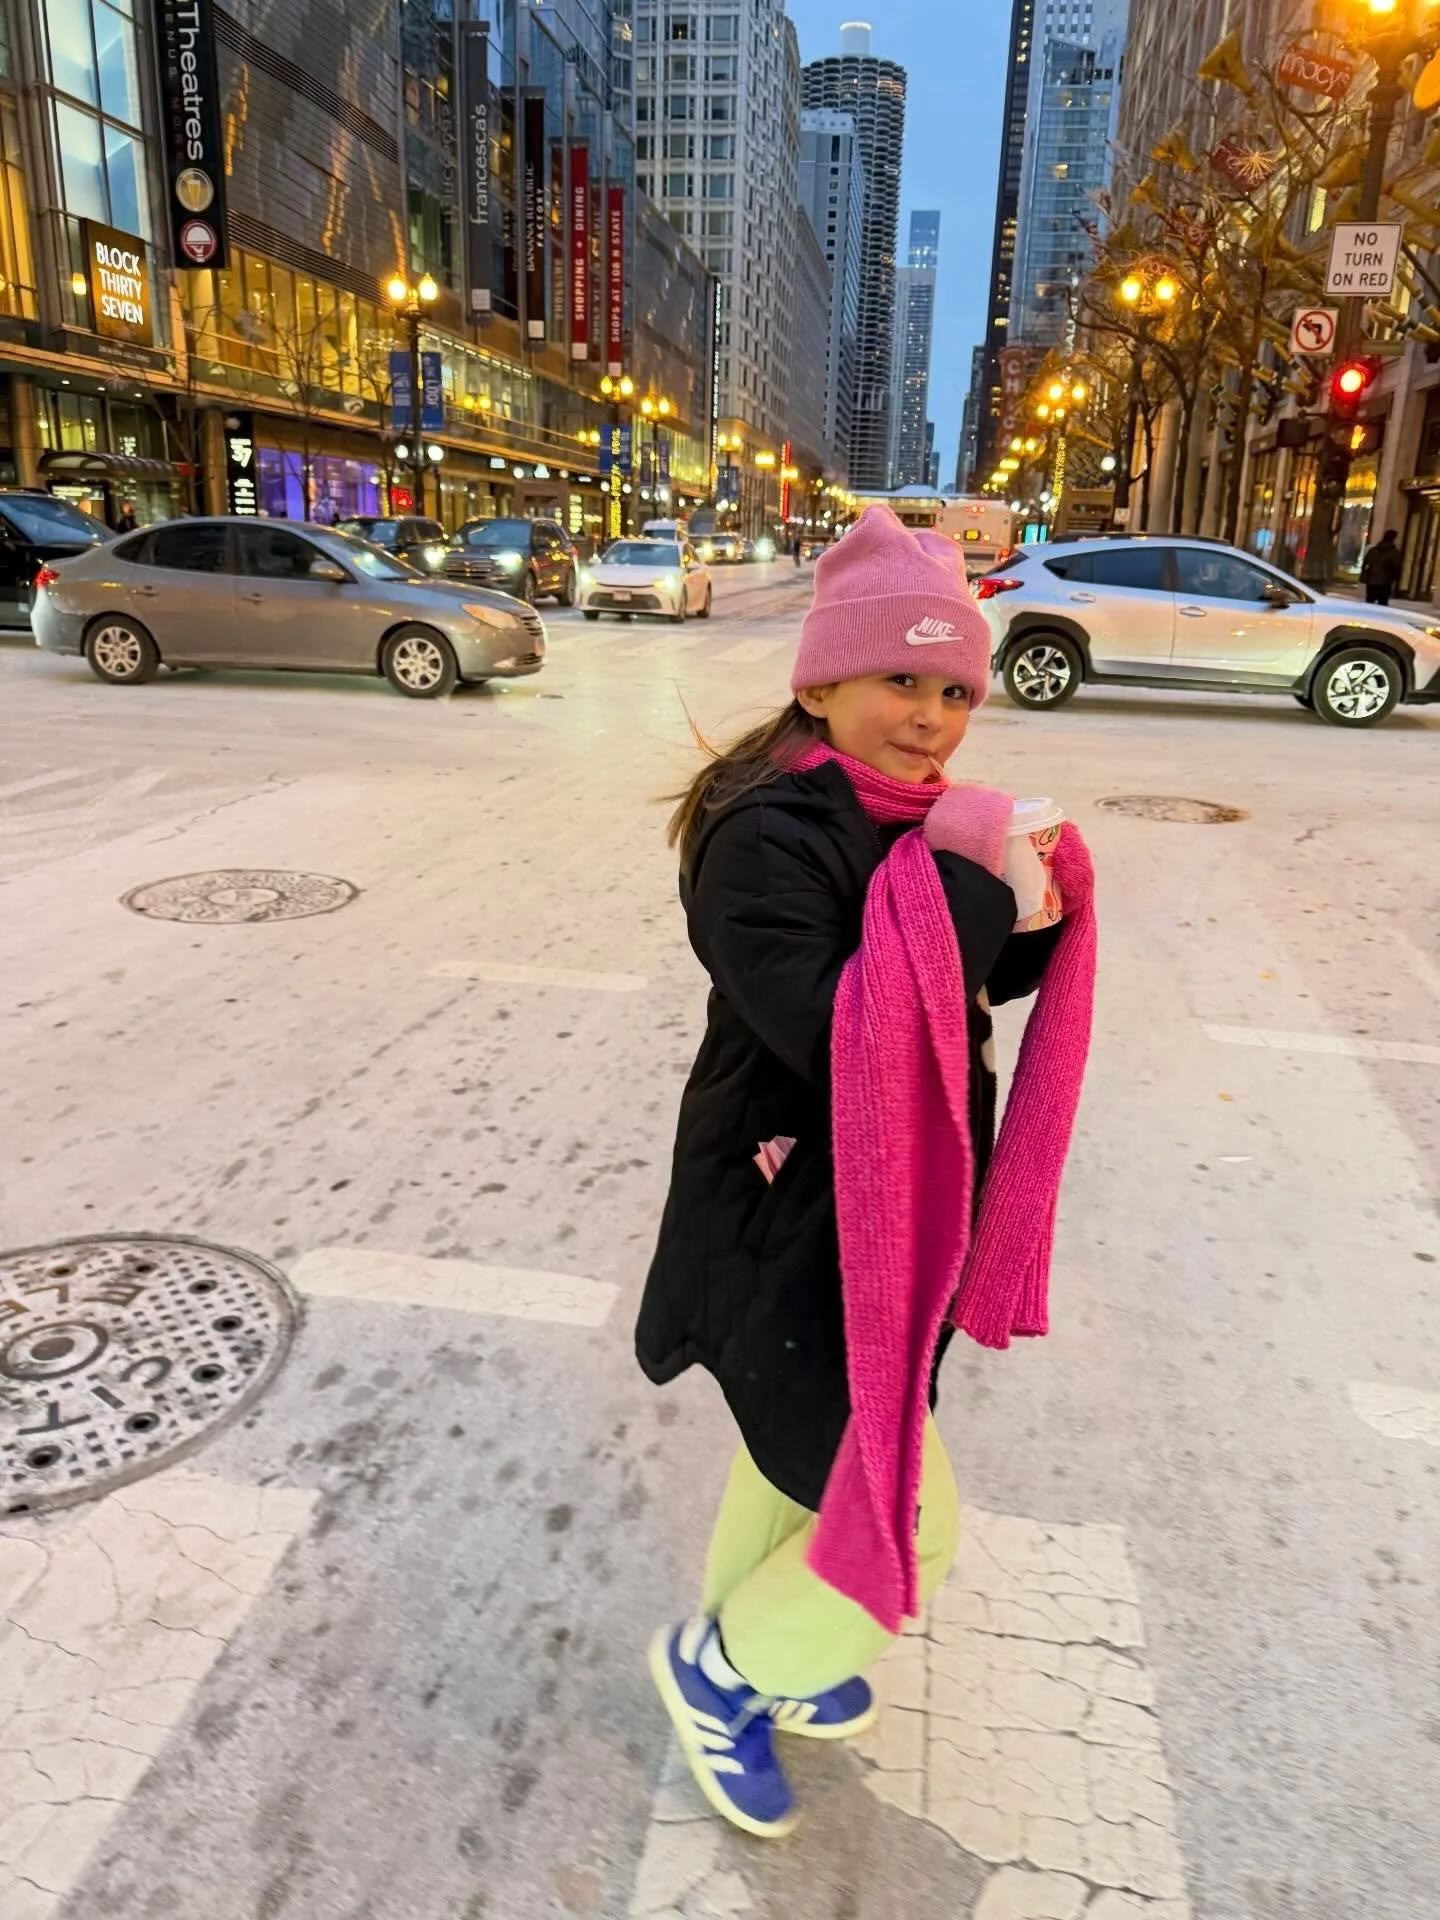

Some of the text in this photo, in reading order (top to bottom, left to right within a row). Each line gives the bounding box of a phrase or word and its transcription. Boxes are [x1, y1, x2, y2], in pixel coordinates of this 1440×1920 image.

[469, 104, 488, 224] francesca's
[526, 162, 535, 271] BANANA REPUBLIC
[536, 187, 545, 247] FACTORY
[575, 186, 585, 231] DINING
[611, 210, 620, 245] STATE
[1354, 232, 1378, 245] NO
[95, 241, 142, 277] BLOCK
[611, 262, 621, 282] 108
[1344, 252, 1383, 266] TURN
[98, 268, 143, 301] THIRTY
[575, 258, 585, 320] SHOPPING
[611, 289, 620, 302] AT
[1332, 272, 1388, 286] ON RED
[101, 293, 144, 325] SEVEN
[611, 307, 620, 342] SHOPS
[916, 616, 956, 636] NIKE
